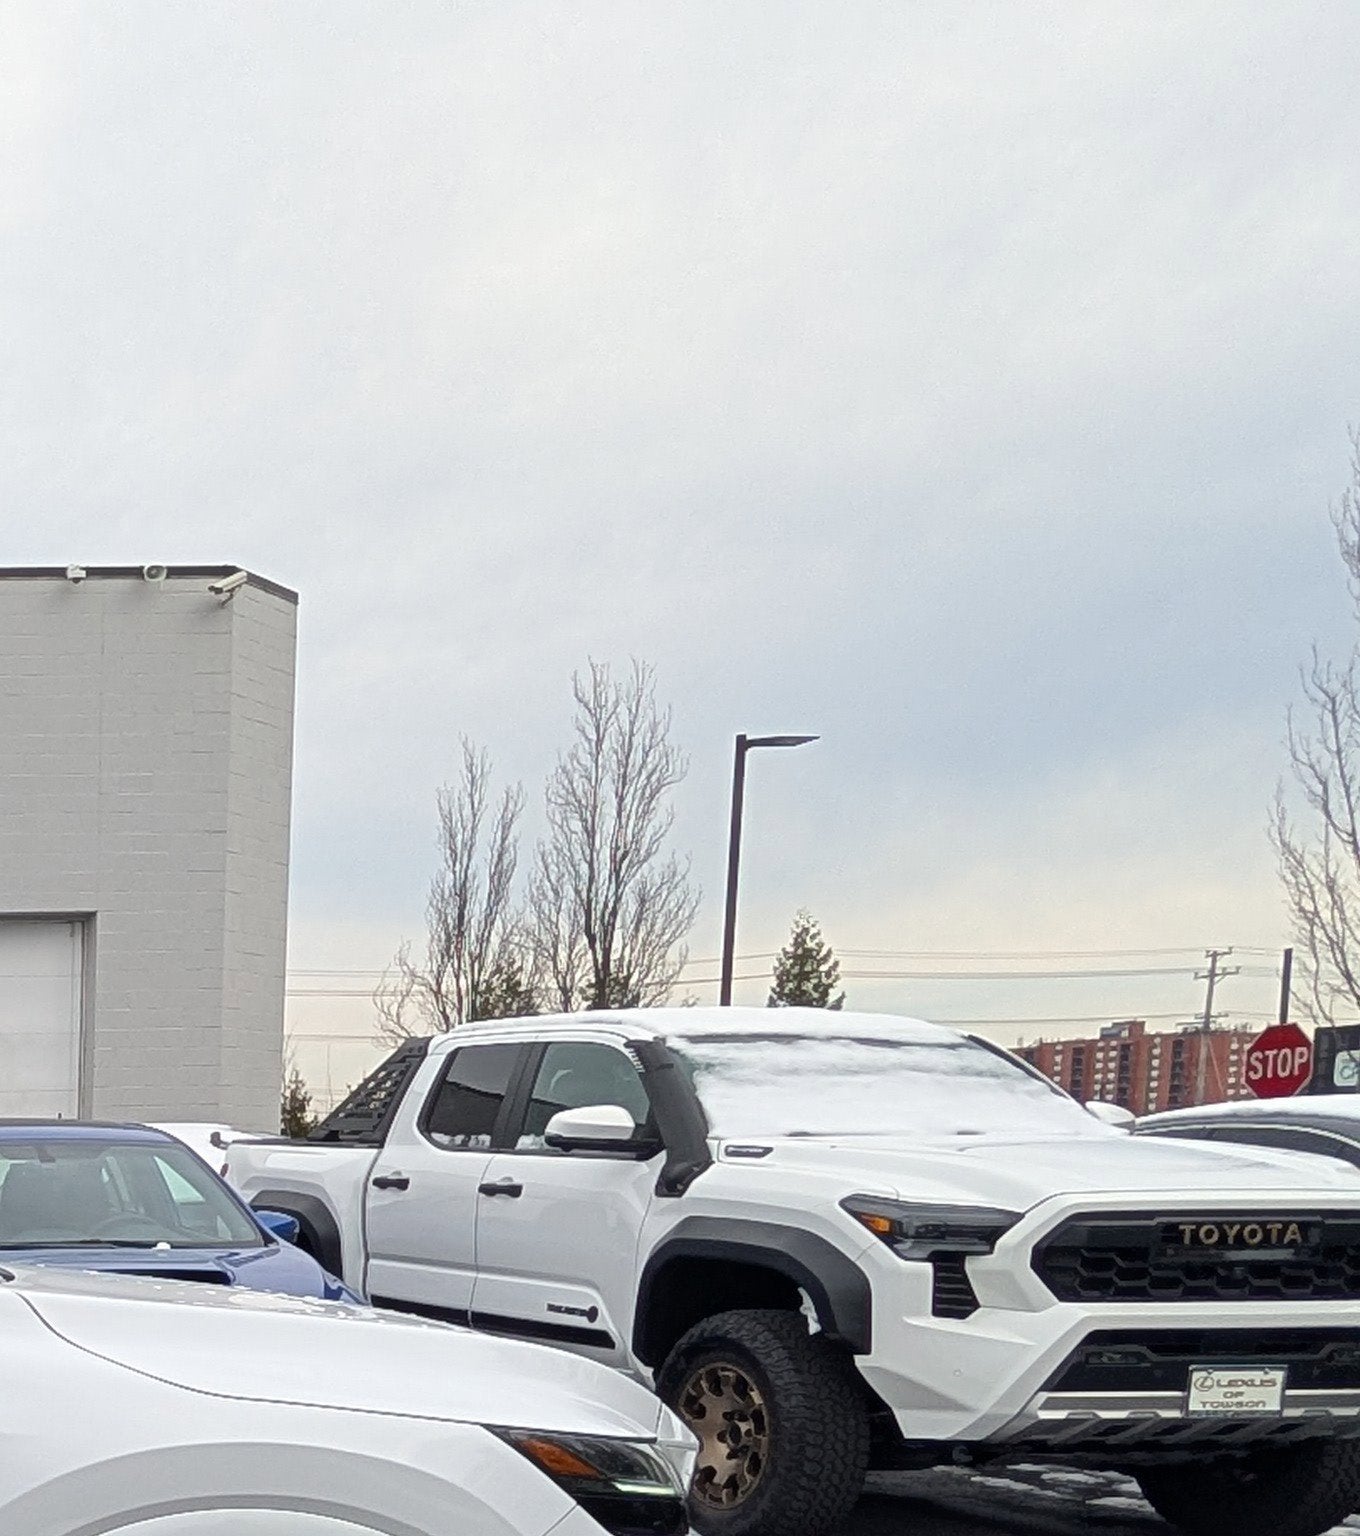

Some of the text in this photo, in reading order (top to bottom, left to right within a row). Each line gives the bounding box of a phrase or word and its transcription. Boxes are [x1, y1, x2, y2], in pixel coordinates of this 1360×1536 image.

[1248, 1047, 1309, 1080] STOP
[1179, 1223, 1303, 1245] TOYOTA
[1216, 1378, 1278, 1388] LEXUS
[1223, 1391, 1246, 1399] OF
